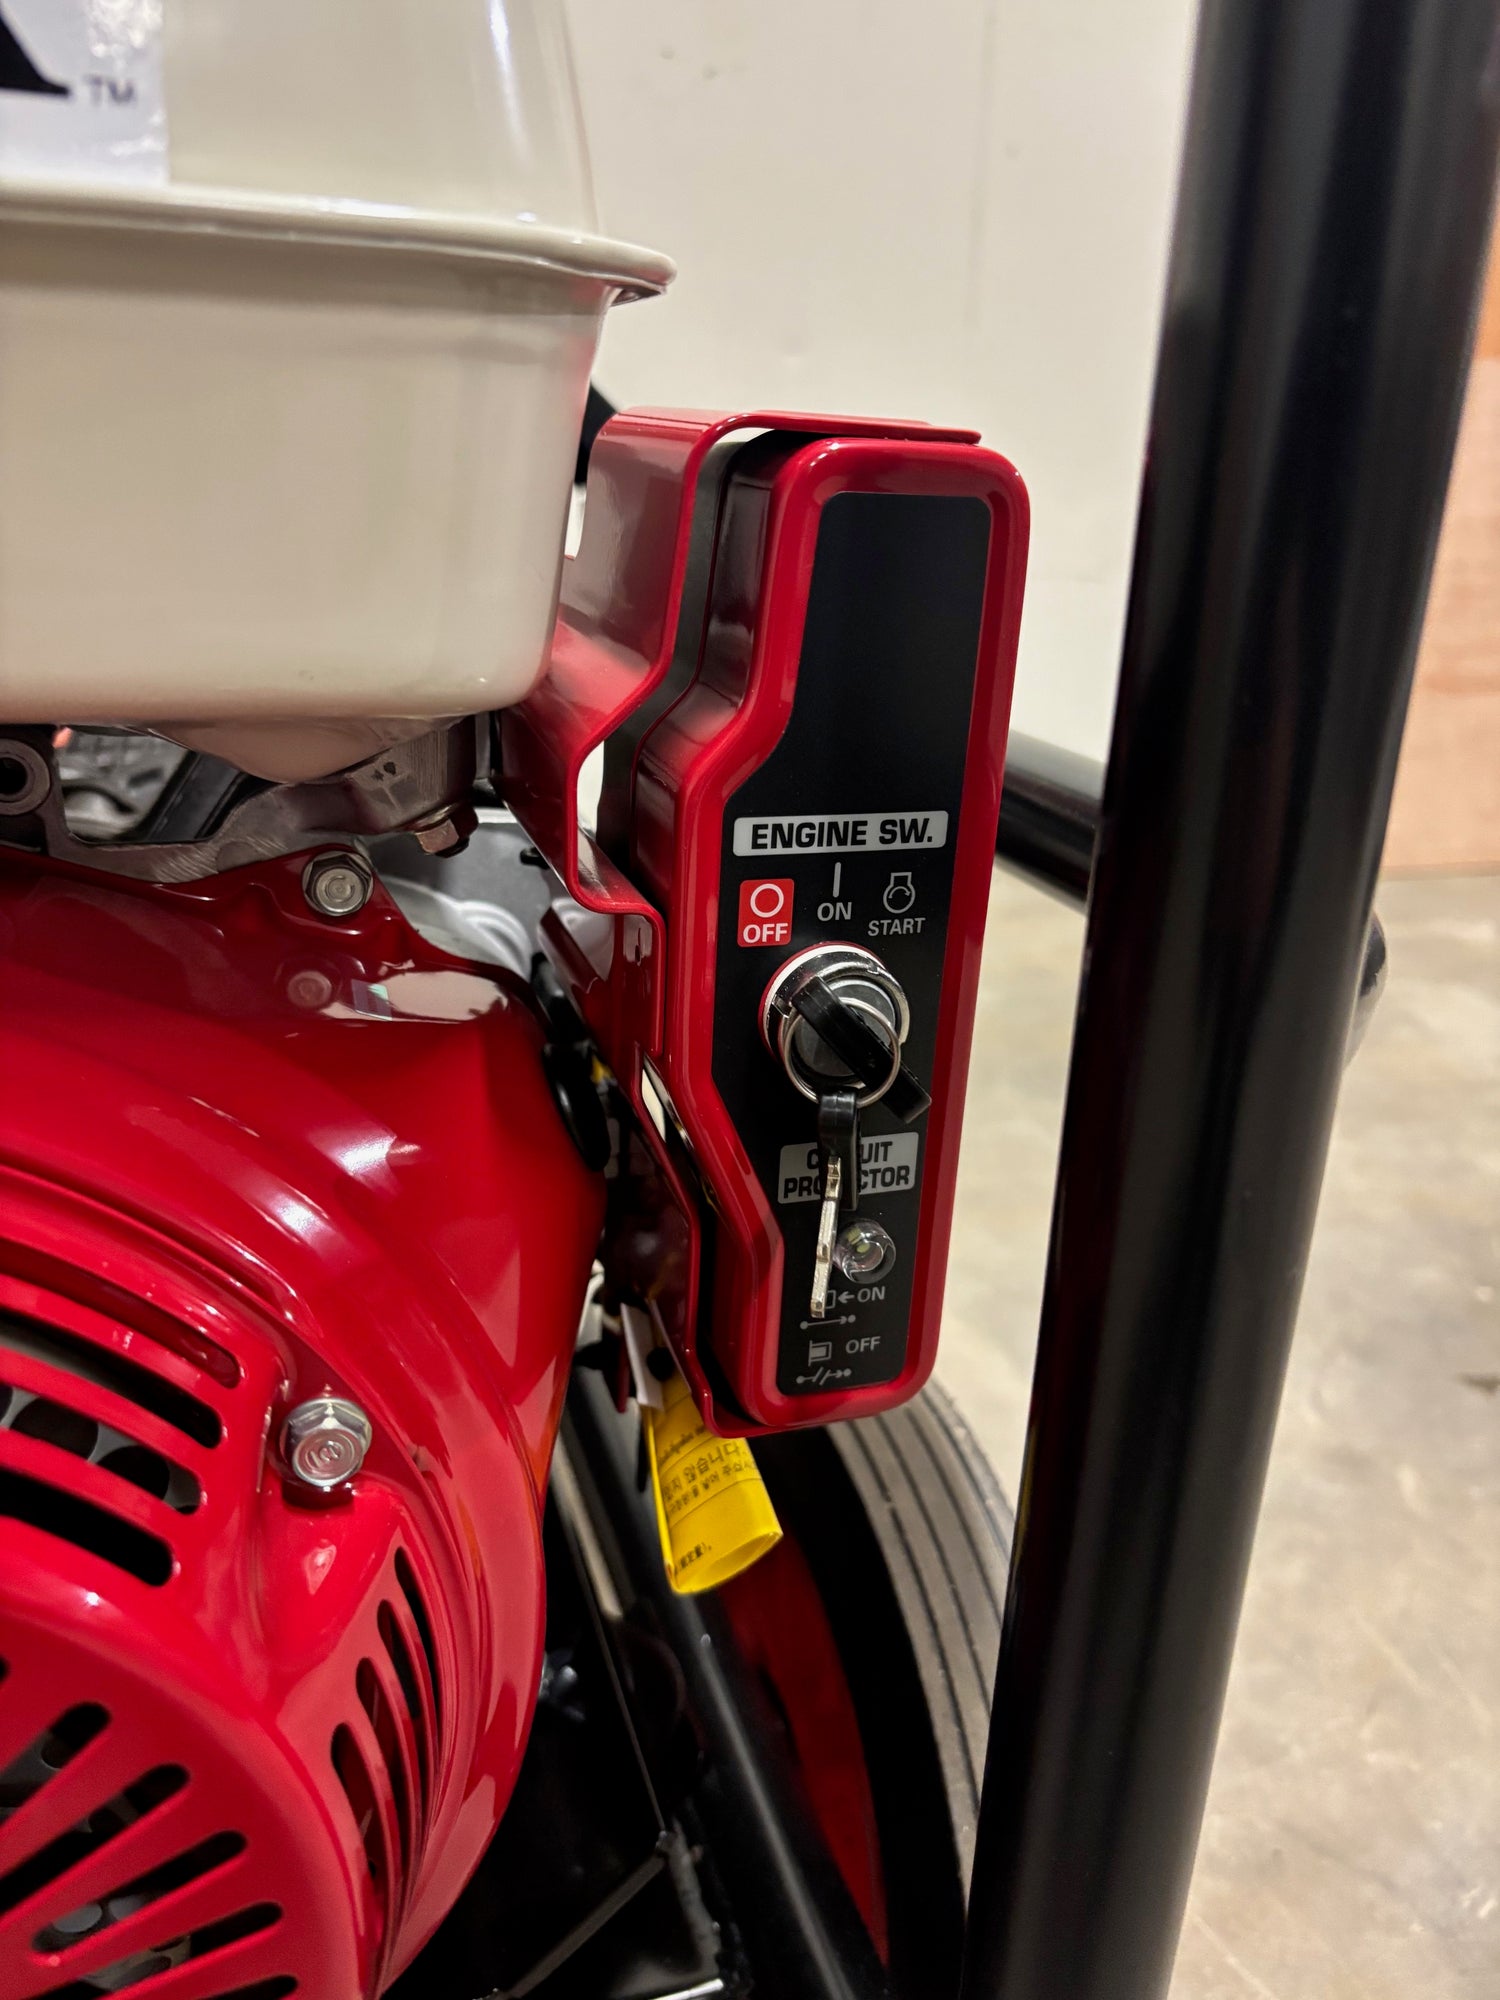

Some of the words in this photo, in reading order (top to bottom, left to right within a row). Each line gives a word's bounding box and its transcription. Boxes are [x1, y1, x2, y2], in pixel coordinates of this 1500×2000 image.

[751, 820, 868, 850] ENGINE
[879, 817, 933, 845] SW.
[817, 901, 852, 922] ON
[742, 922, 788, 944] OFF
[867, 917, 926, 937] START
[806, 1141, 893, 1170] CUIT
[857, 1285, 886, 1302] ON
[845, 1336, 881, 1355] OFF
